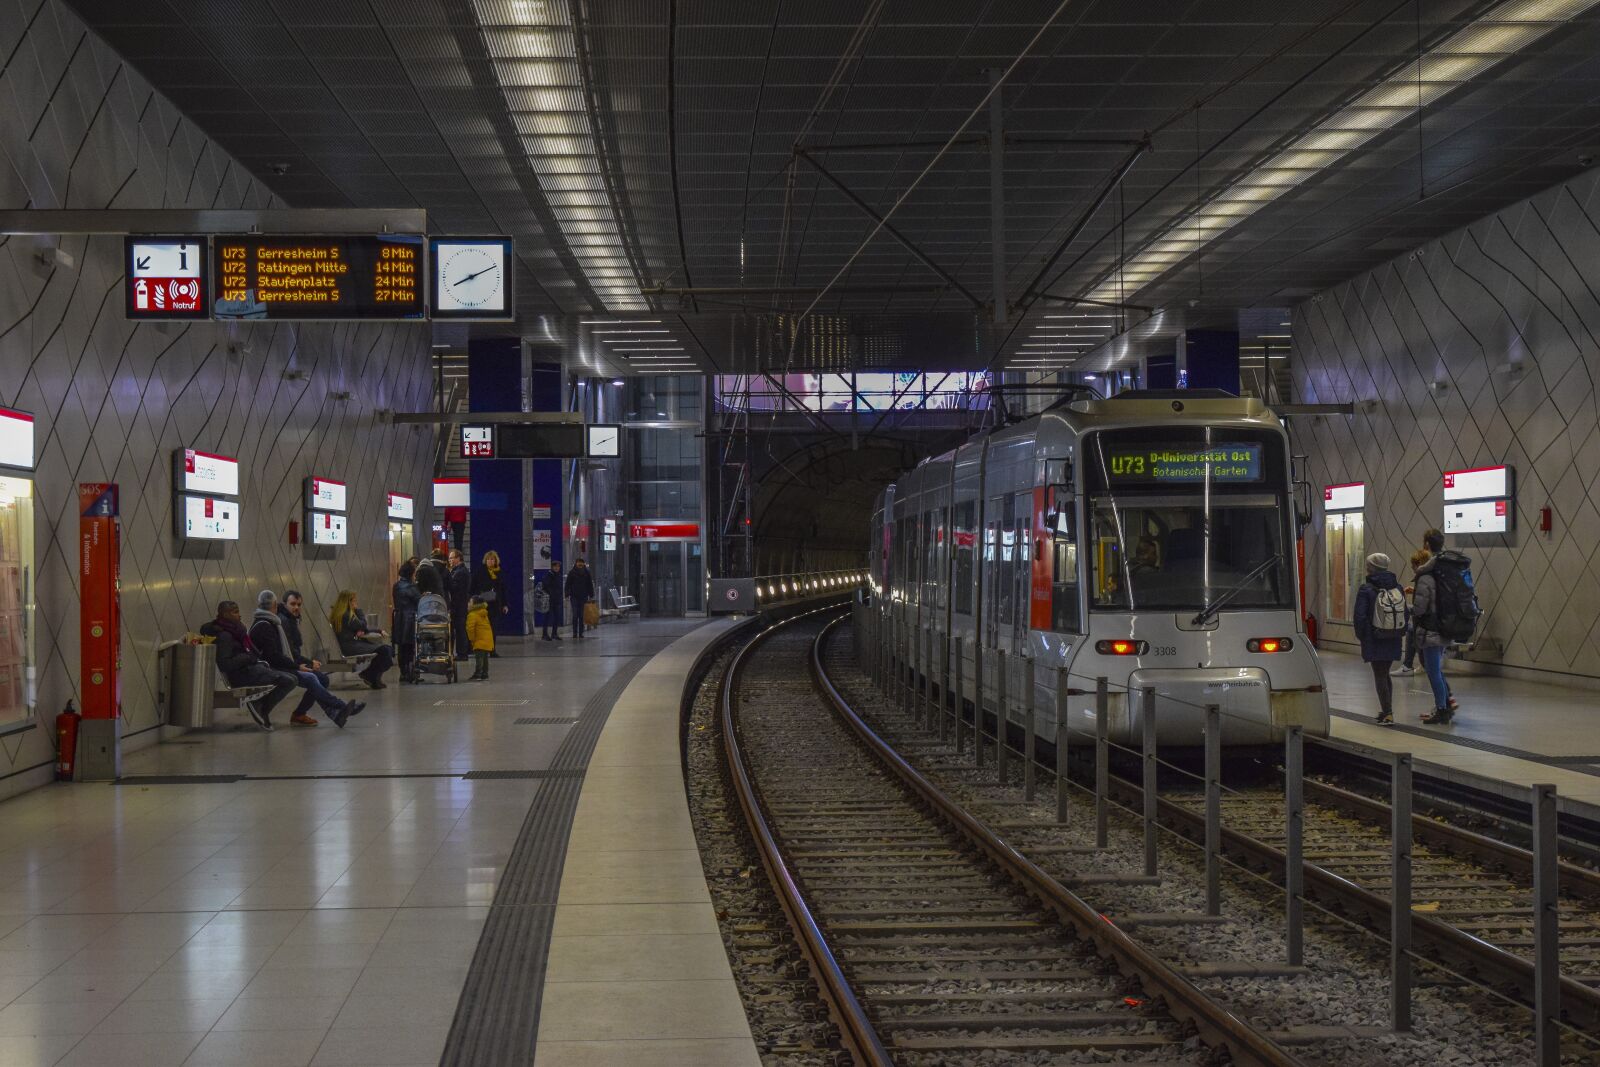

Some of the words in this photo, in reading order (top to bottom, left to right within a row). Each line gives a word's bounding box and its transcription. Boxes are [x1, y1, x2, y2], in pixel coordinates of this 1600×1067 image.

[223, 247, 247, 259] U73
[257, 247, 328, 259] Gerresheim
[330, 247, 340, 259] S
[381, 247, 390, 259] 8
[391, 247, 414, 259] Min
[223, 261, 247, 273] U72
[257, 261, 313, 275] Ratingen
[314, 261, 348, 273] Mitte
[375, 261, 390, 273] 14
[391, 261, 414, 273] Min
[223, 275, 247, 287] U72
[257, 275, 336, 289] Staufenplatz
[375, 275, 390, 287] 24
[391, 275, 414, 287] Min
[223, 289, 247, 301] U73
[257, 289, 328, 301] Gerresheim
[330, 289, 340, 301] S
[375, 289, 390, 301] 27
[391, 289, 415, 301] Min
[172, 301, 196, 310] Notruf
[1111, 456, 1145, 474] U73
[1149, 450, 1228, 463] D-Universität
[1231, 451, 1251, 462] Ost
[1214, 465, 1248, 477] Garten
[81, 484, 101, 496] SOS
[1154, 646, 1177, 657] 3308
